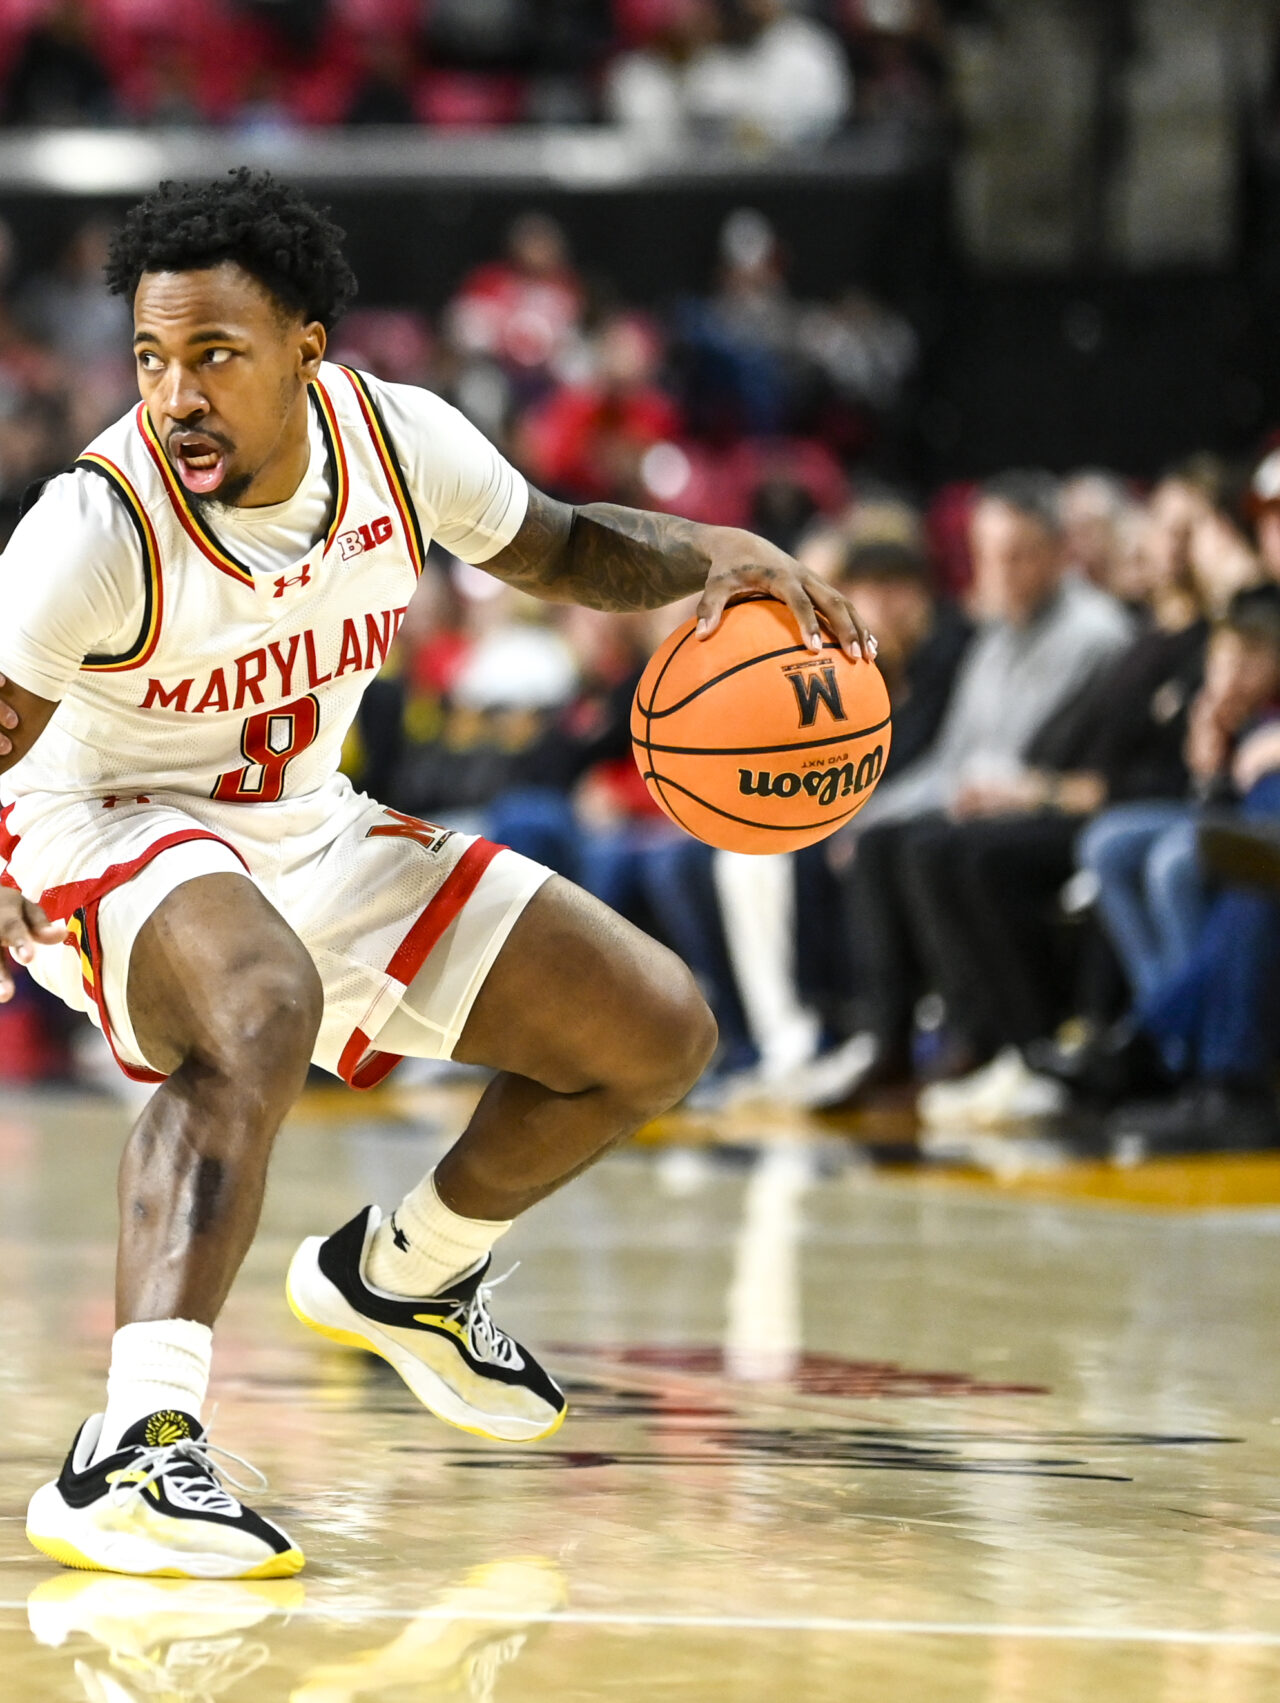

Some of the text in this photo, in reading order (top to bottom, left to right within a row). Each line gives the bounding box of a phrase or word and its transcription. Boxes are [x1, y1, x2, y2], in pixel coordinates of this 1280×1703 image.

[785, 666, 848, 729] M
[209, 692, 320, 803] 8
[739, 745, 883, 806] Wilson
[801, 753, 849, 769] EVO NXT
